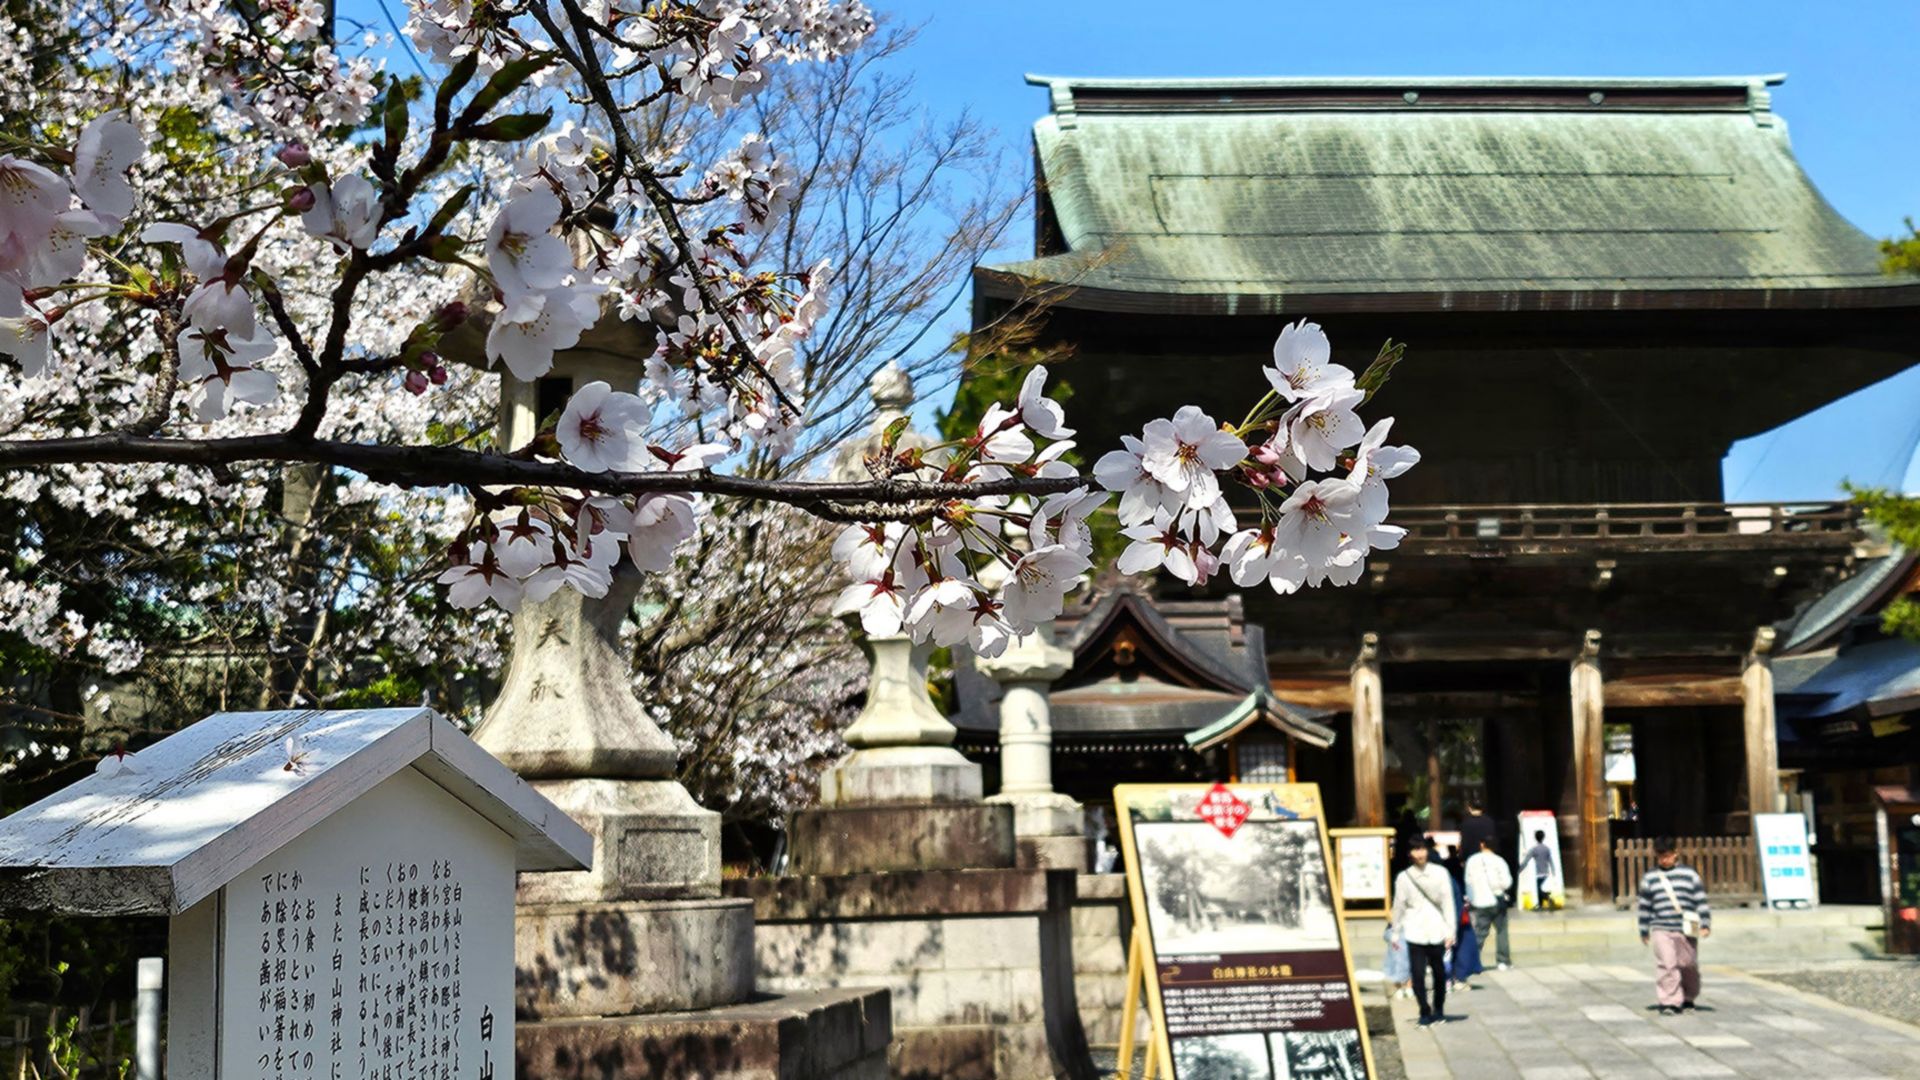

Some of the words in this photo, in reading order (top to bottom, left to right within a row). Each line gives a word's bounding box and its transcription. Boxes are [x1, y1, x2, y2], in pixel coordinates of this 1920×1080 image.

[258, 873, 272, 1080] である歯がいつ
[273, 872, 288, 1080] に除災招福箸を
[287, 870, 303, 1080] かなうとされて
[302, 899, 316, 1080] お食い初めの
[330, 893, 343, 1080] また白山神社に
[359, 866, 370, 1080] に成長されるよう
[407, 863, 419, 1080] の健やかな成長を
[453, 882, 463, 1080] 白山さまは古くよ
[480, 1004, 494, 1080] 白山
